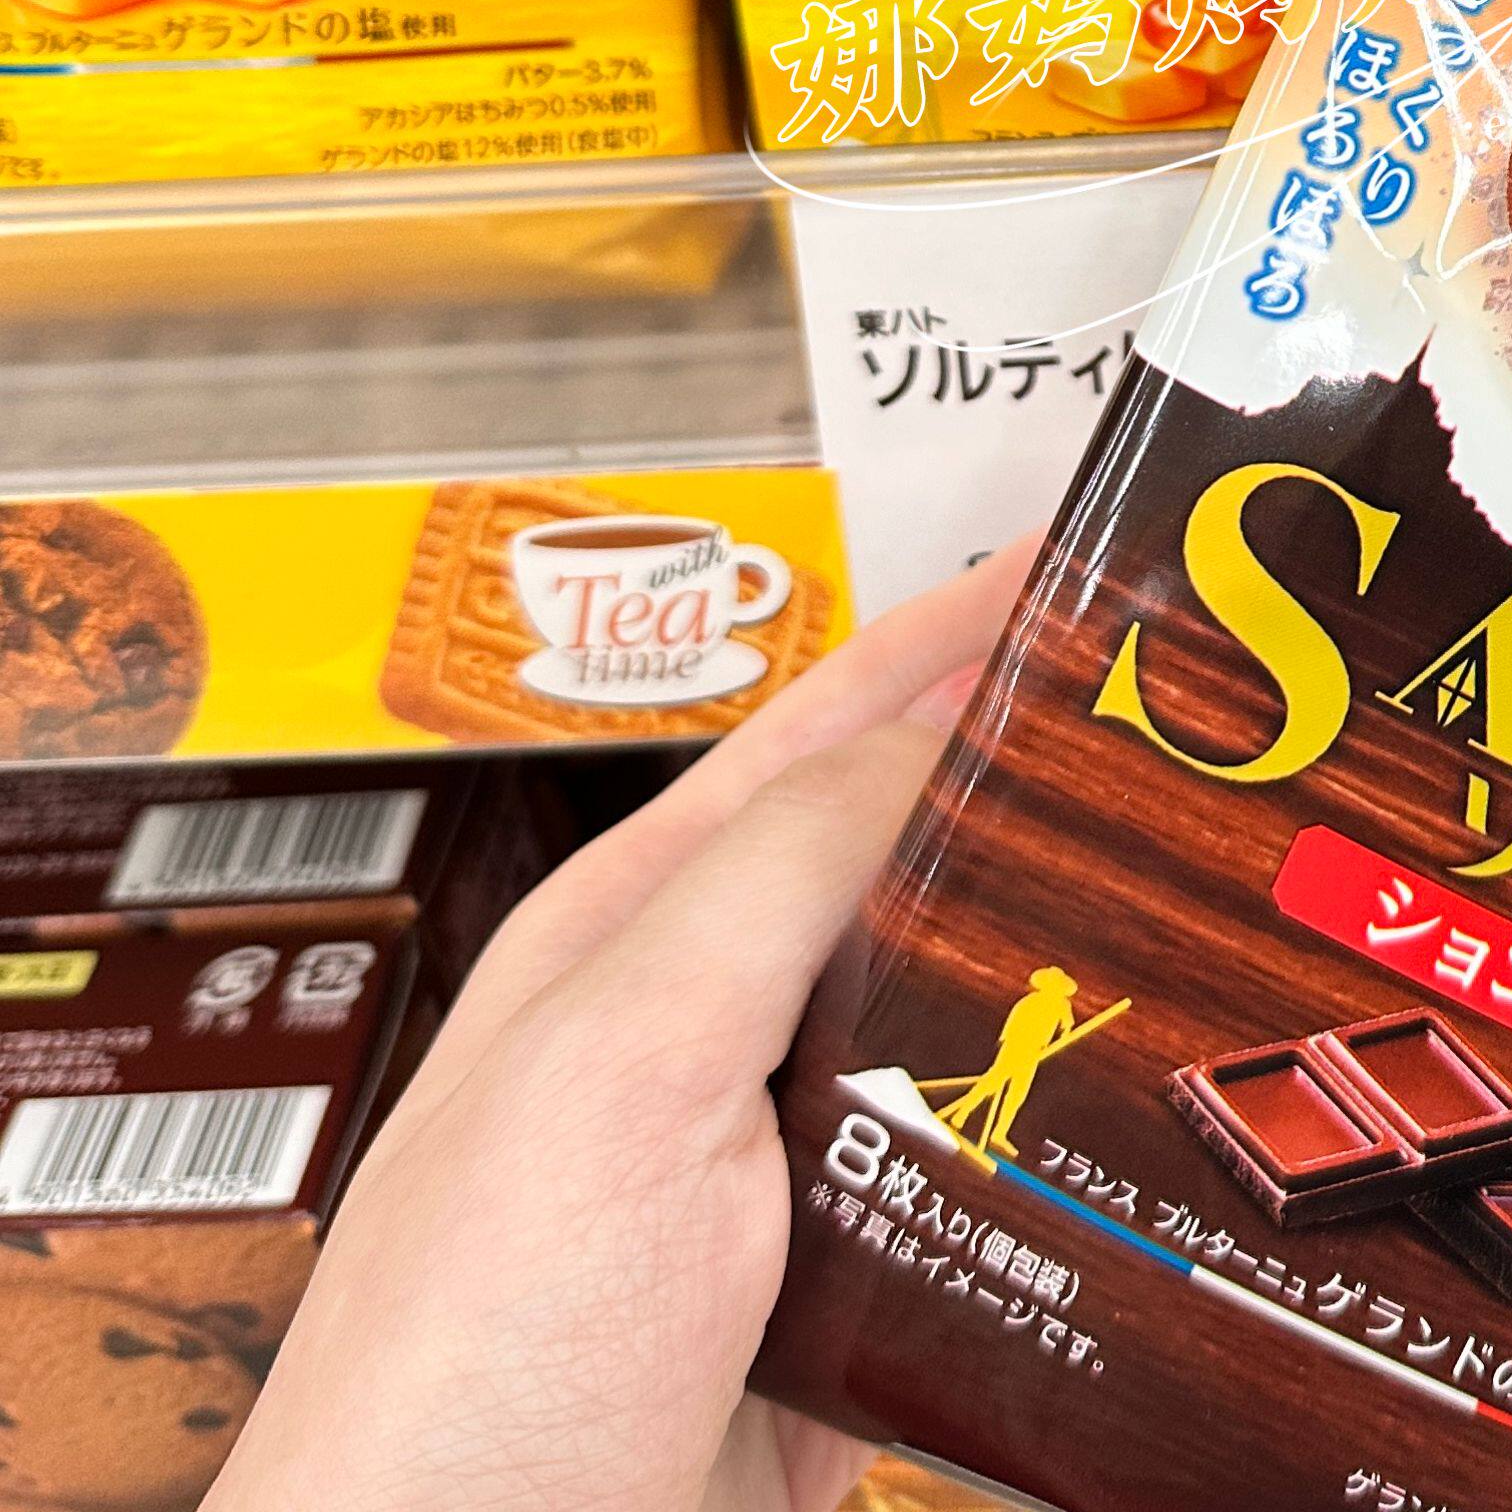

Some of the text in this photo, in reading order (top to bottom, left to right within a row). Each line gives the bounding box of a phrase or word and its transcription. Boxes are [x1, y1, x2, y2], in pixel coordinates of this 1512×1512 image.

[1245, 26, 1401, 323] ほろほろ
[855, 305, 948, 338] 東ハト
[860, 328, 1136, 408] ソルティ
[648, 524, 728, 590] with
[552, 571, 714, 650] Tea
[823, 1112, 1082, 1314] 8枚入り(個包装)
[1038, 1137, 1143, 1222] フランス
[807, 1178, 1106, 1378] ※写真はイメージです。
